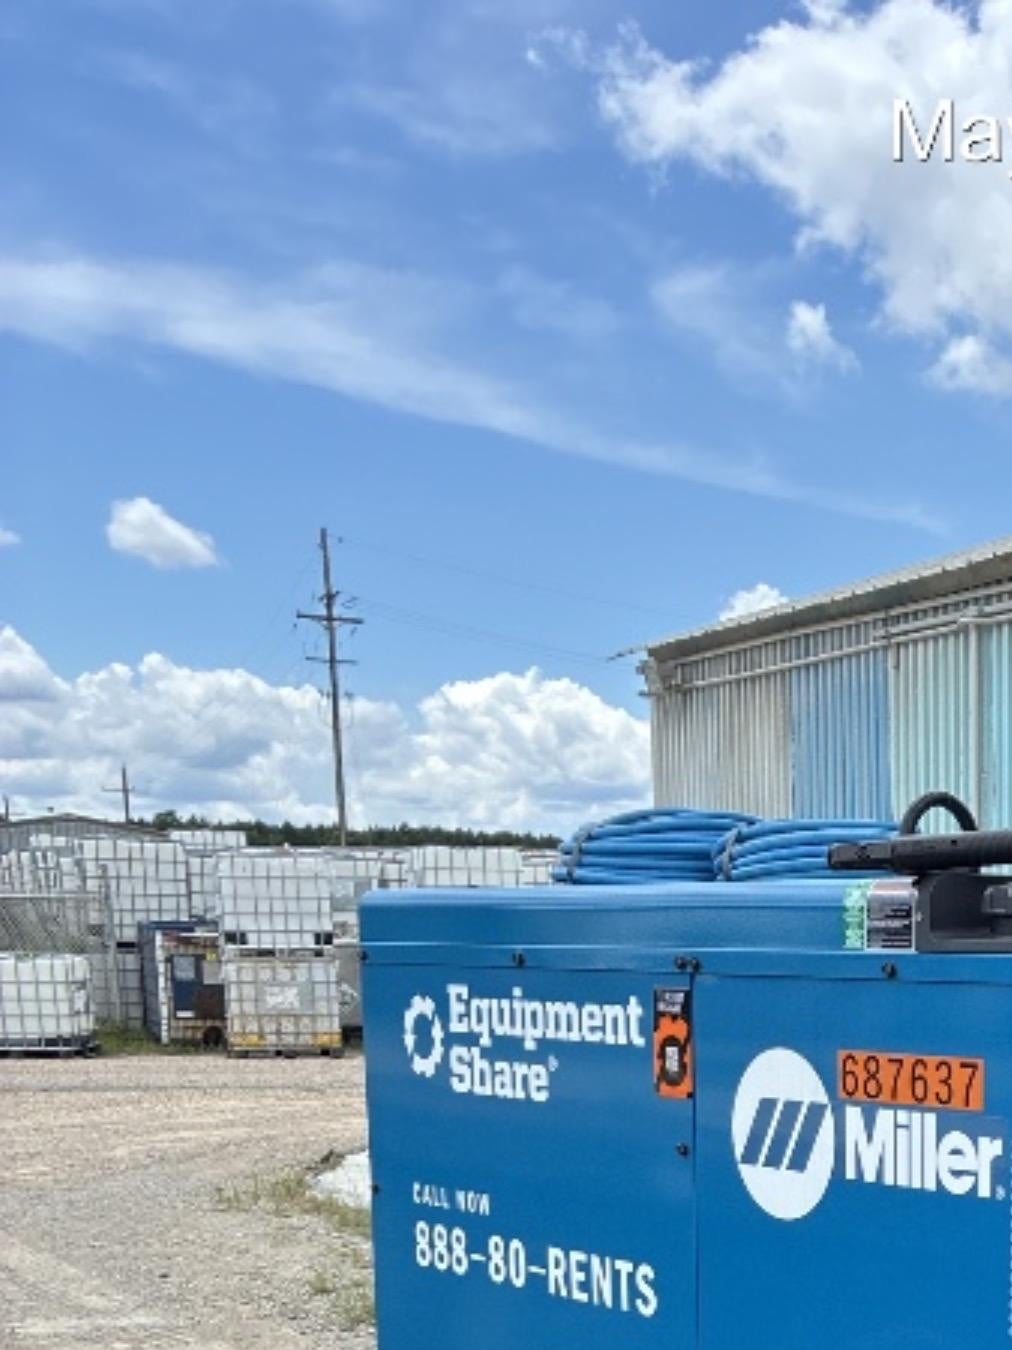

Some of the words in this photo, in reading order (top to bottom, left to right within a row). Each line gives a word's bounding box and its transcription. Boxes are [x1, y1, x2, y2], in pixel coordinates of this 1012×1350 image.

[446, 983, 646, 1050] Equipment
[842, 1053, 979, 1108] 687637
[845, 1104, 1003, 1198] Miller
[412, 1181, 449, 1210] CALL
[455, 1189, 490, 1216] NOW
[415, 1220, 659, 1318] 888-80-RENTS
